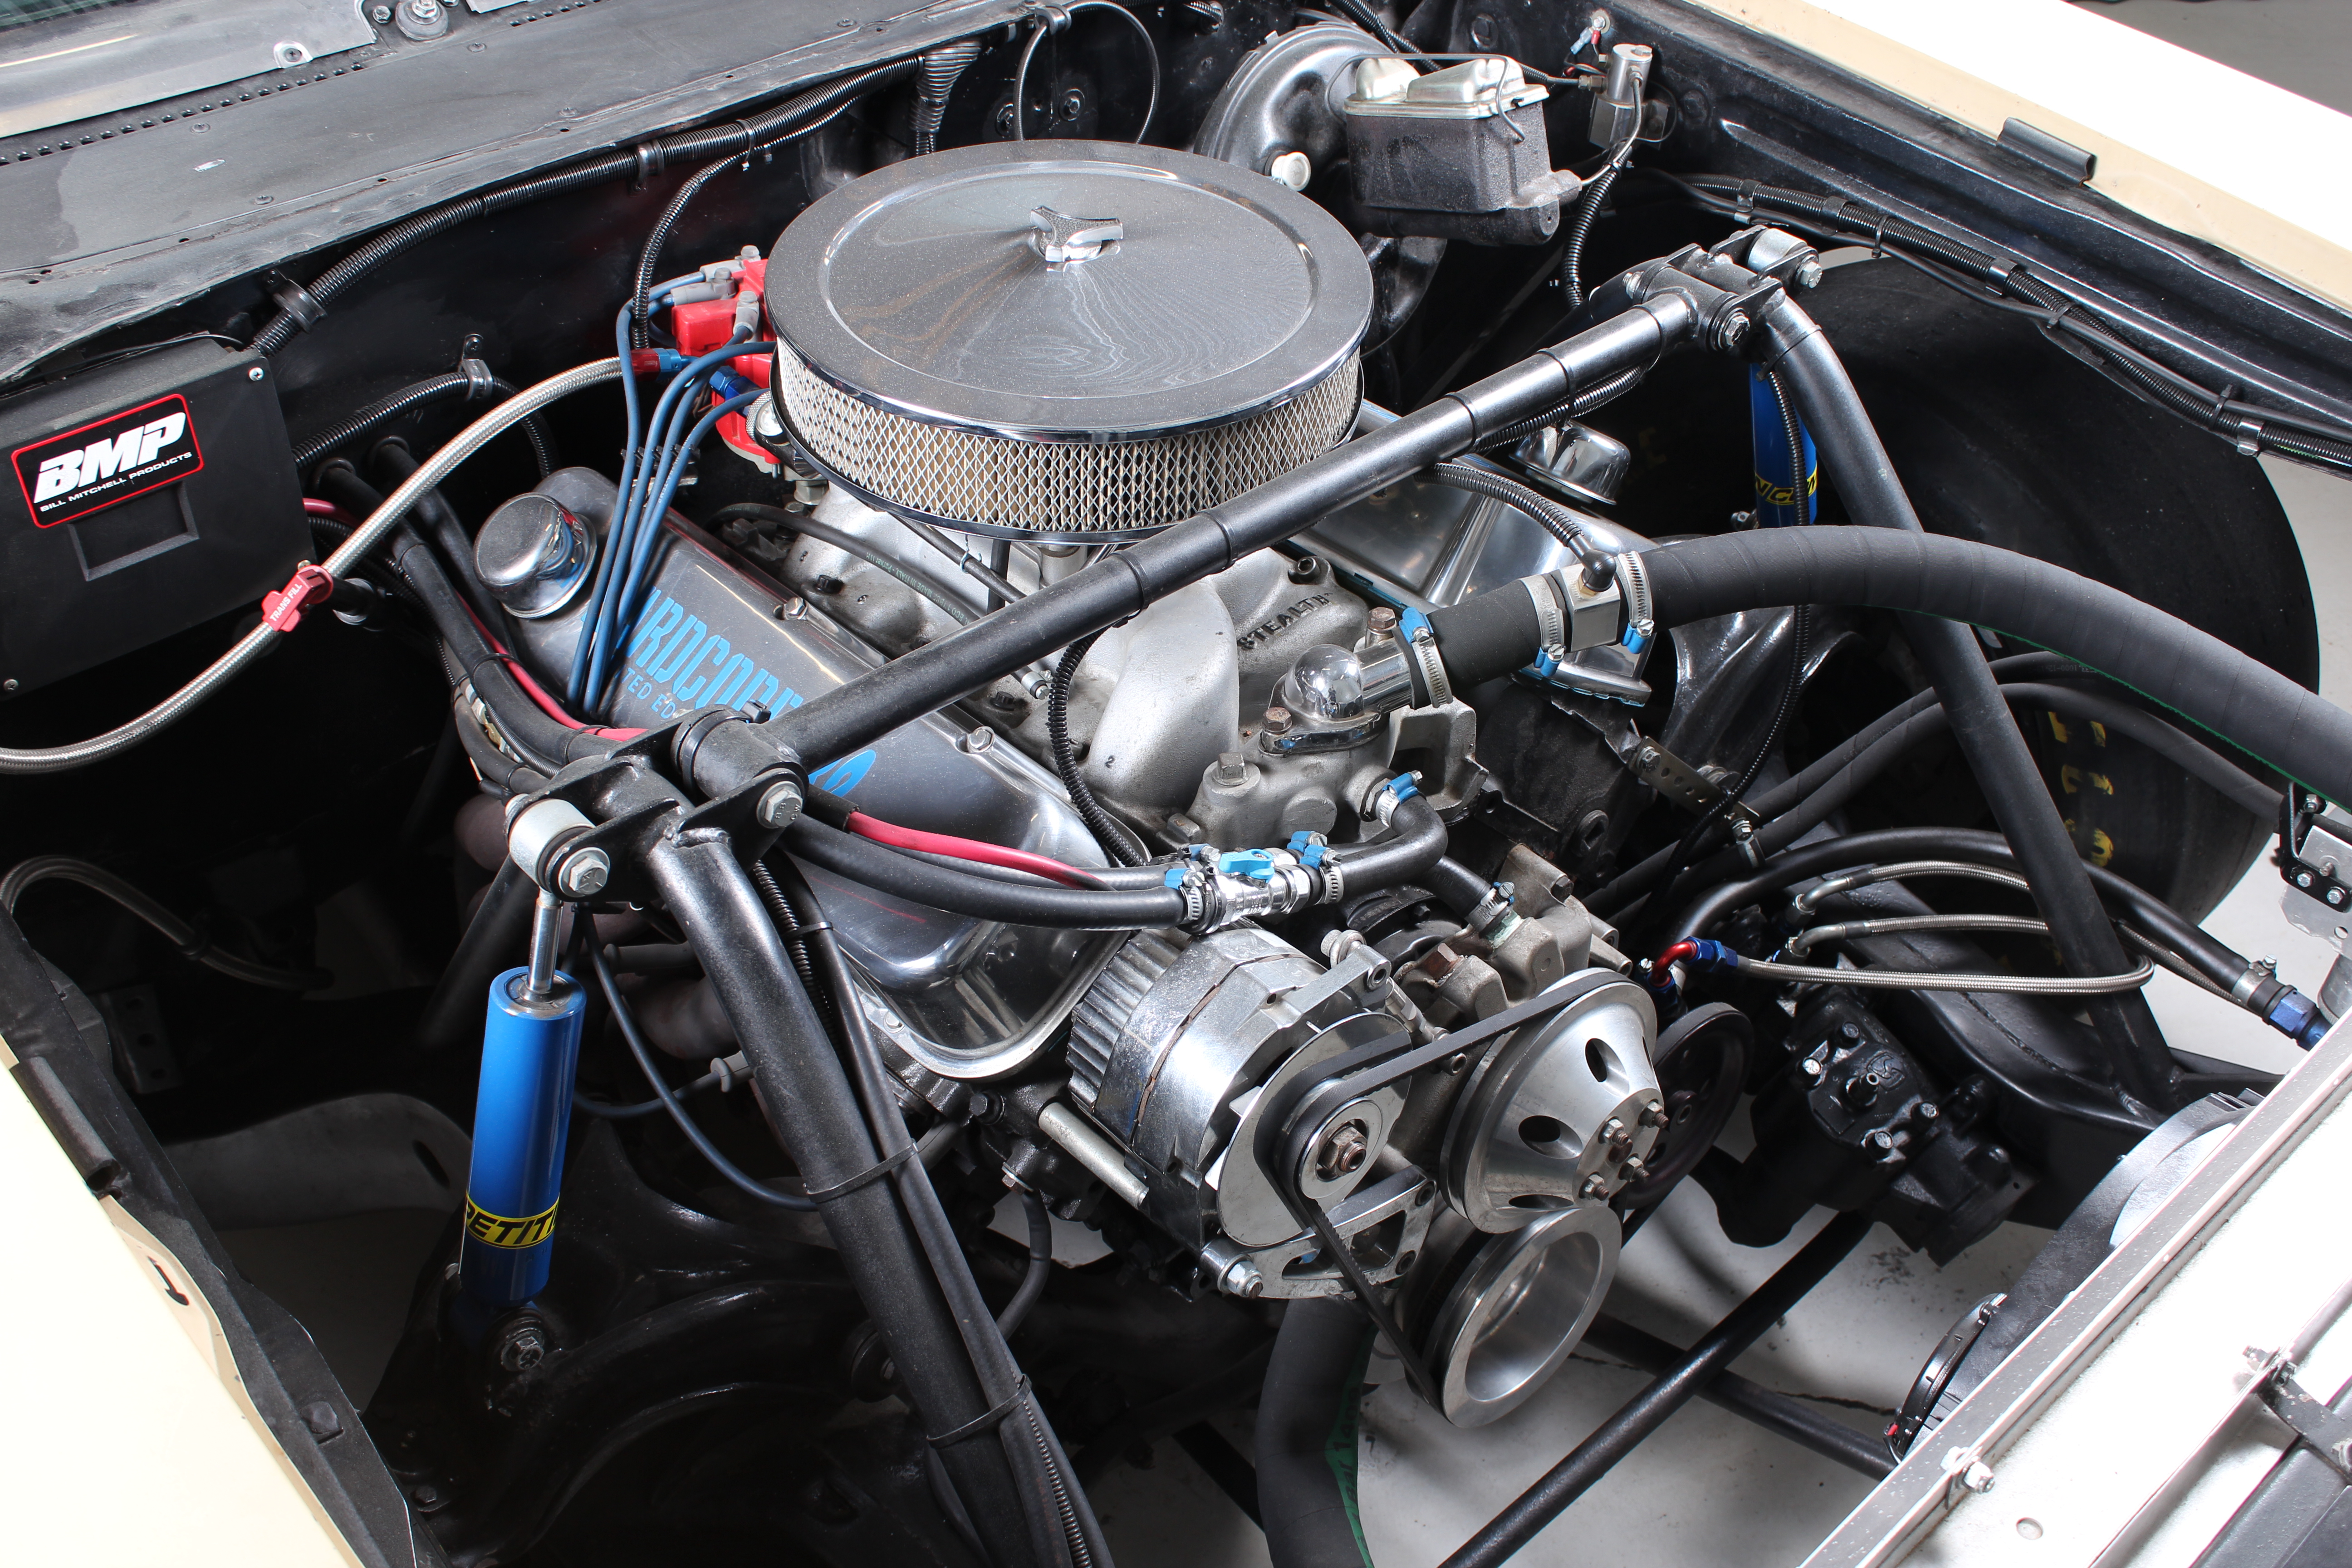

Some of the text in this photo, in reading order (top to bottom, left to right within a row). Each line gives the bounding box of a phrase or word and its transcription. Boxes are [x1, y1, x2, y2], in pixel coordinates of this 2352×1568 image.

[34, 412, 186, 504] BMP
[39, 451, 192, 512] BILL MITCHELL PRODUCTS
[270, 583, 303, 621] TRANS FILL
[910, 578, 916, 588] IN
[916, 582, 932, 598] MADE
[1237, 593, 1330, 651] STEALTH
[1105, 755, 1115, 768] 2
